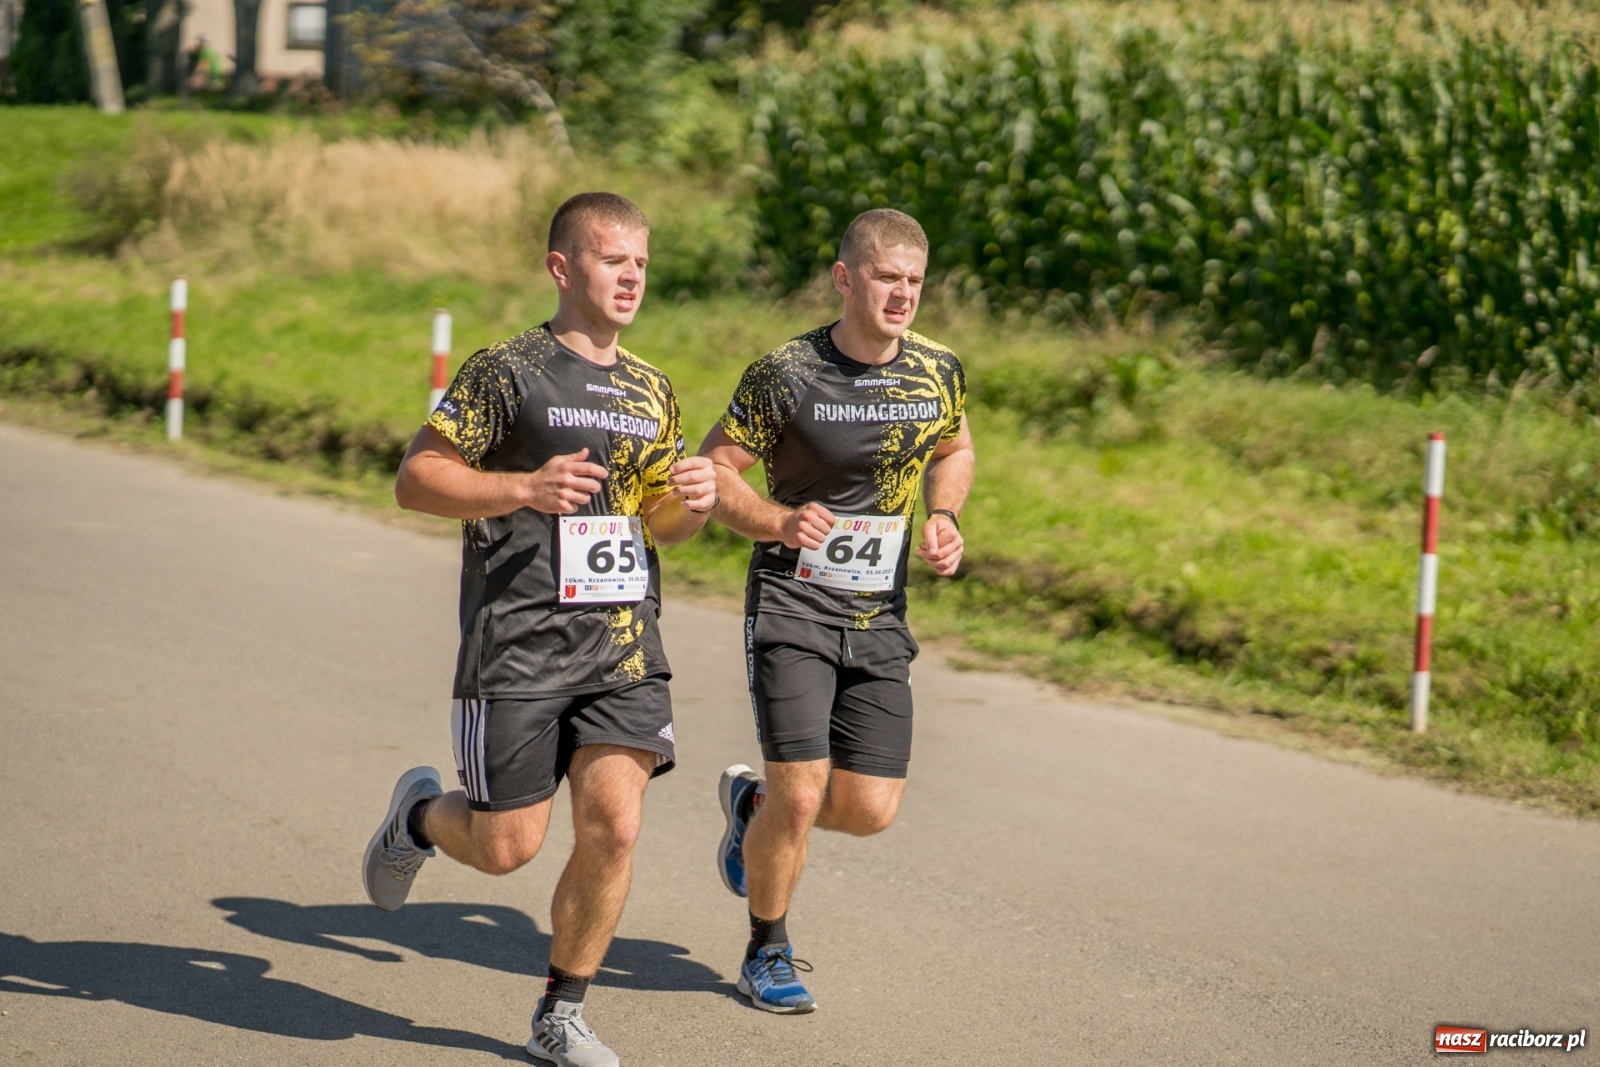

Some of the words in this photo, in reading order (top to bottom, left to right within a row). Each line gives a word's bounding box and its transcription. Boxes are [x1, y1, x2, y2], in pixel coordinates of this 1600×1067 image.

[586, 383, 627, 397] SMMASH
[854, 379, 900, 387] SMMASH
[814, 400, 938, 421] RUNMAGEDDON
[547, 406, 658, 440] RUNMAGEDDON
[569, 522, 624, 537] COLOUR
[877, 521, 900, 535] RUN
[587, 540, 636, 574] 65
[826, 535, 882, 567] 64
[746, 616, 755, 650] DZIK
